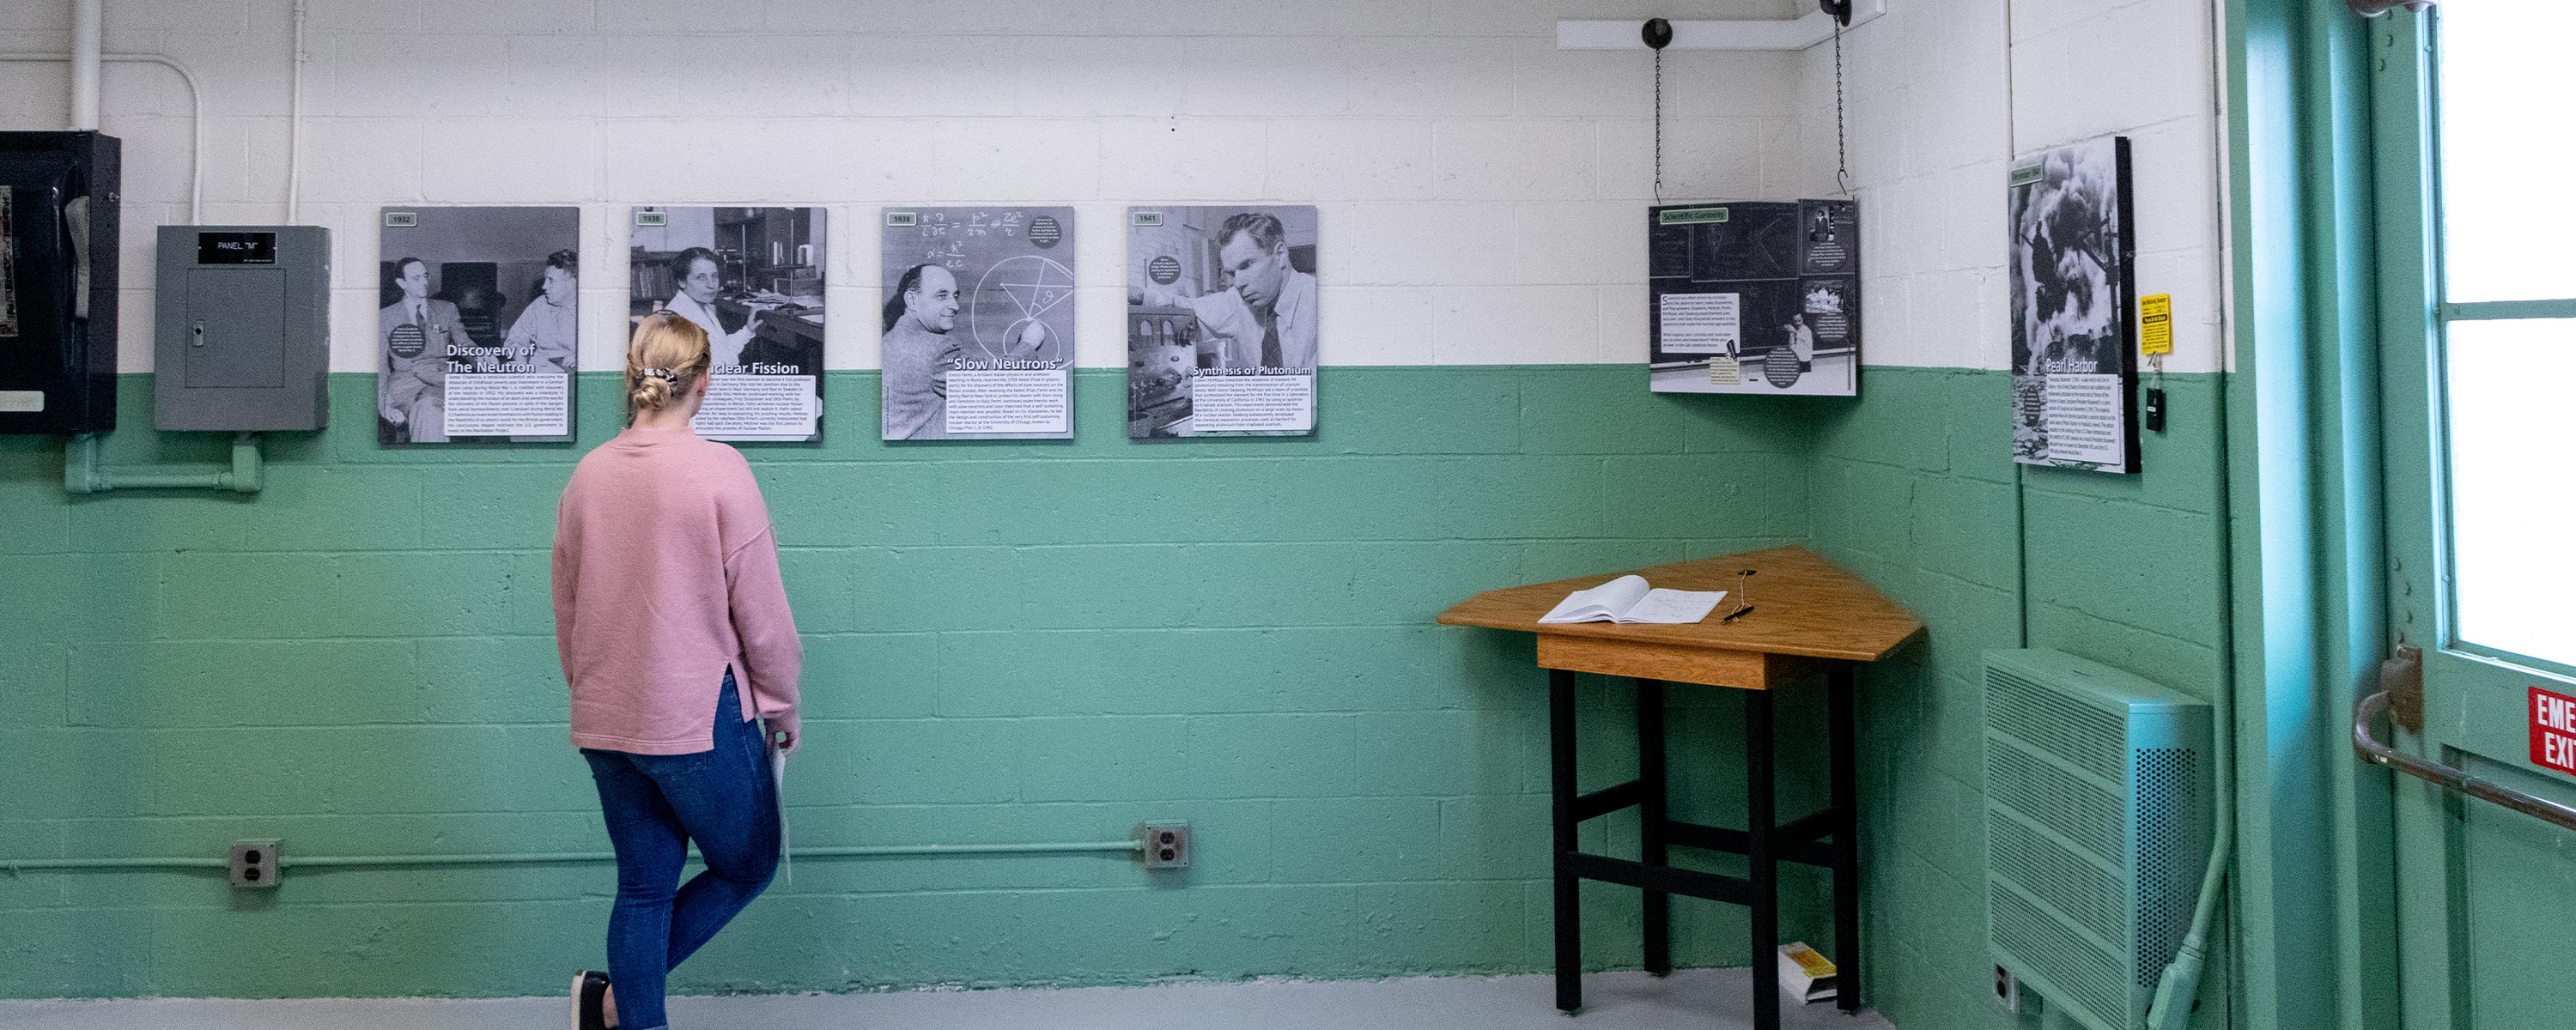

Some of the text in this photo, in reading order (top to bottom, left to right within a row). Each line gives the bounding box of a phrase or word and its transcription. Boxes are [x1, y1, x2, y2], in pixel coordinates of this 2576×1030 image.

[1695, 211, 1724, 220] Curiosity
[447, 344, 536, 359] Discovery of
[447, 360, 535, 373] The Neutron
[752, 361, 799, 374] Fission
[2046, 356, 2098, 373] Pearl Harbor
[1193, 366, 1311, 377] Synthesis of Plutonium
